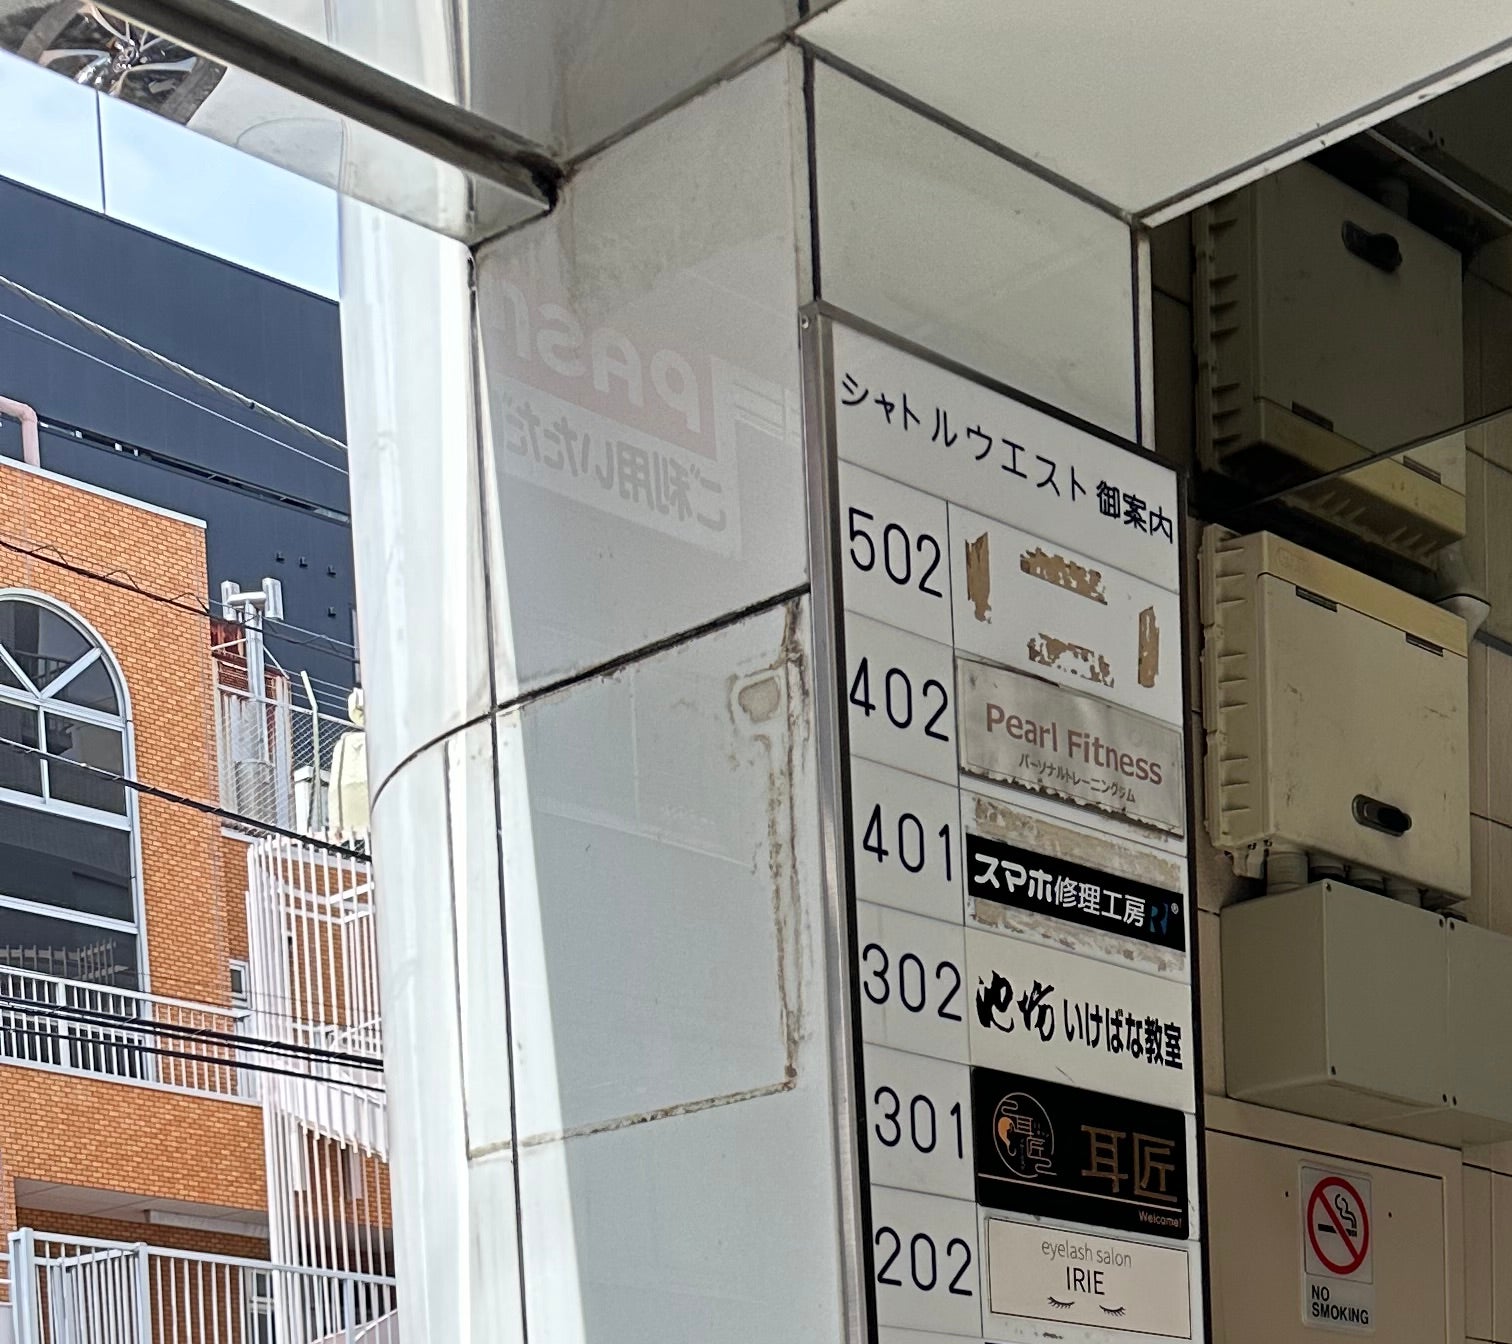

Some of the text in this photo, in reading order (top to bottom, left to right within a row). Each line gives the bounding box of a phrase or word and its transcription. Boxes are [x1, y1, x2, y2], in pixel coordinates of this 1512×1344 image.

[848, 507, 943, 599] 502
[849, 656, 950, 743] 402
[986, 703, 1163, 785] Pearl Fitness
[862, 803, 953, 882] 401
[974, 852, 1146, 928] スマホ修理工房
[863, 943, 963, 1024] 302
[1063, 998, 1184, 1070] いけばな教室
[873, 1086, 964, 1160] 301
[1081, 1124, 1178, 1202] 耳匠
[876, 1227, 973, 1297] 202
[1041, 1240, 1132, 1268] eyelash salon
[1066, 1266, 1105, 1295] IRIE
[1311, 1284, 1330, 1302] NO
[1311, 1301, 1369, 1325] SMOKING
